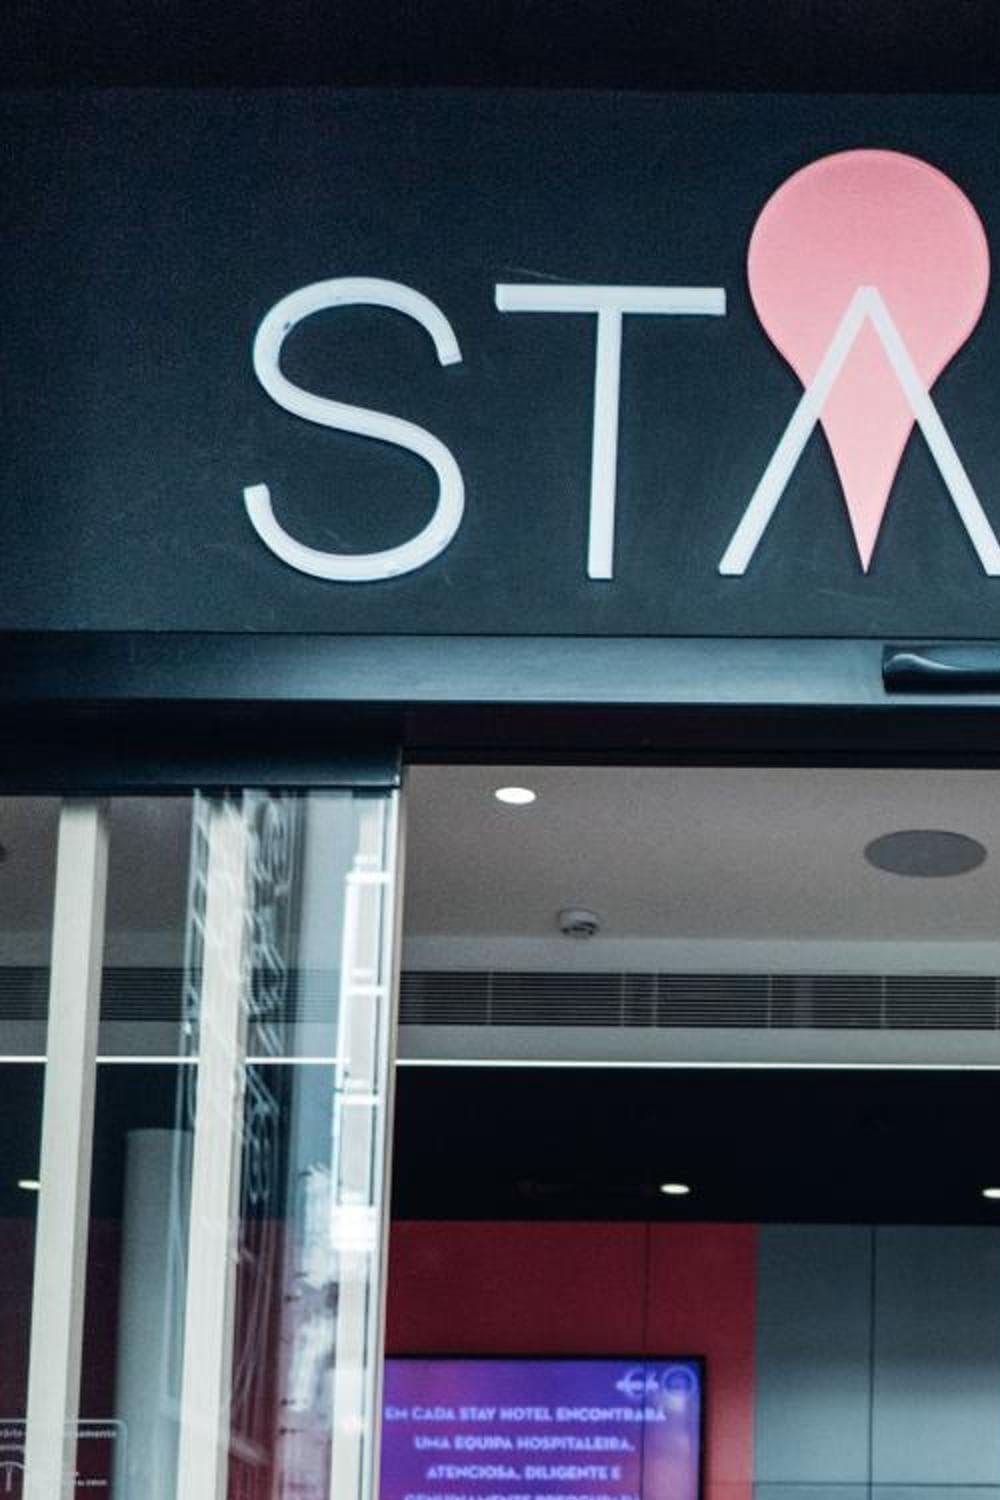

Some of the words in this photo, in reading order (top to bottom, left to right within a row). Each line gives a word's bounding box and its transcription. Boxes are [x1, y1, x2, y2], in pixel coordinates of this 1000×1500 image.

[411, 1407, 455, 1420] CADA
[459, 1407, 497, 1420] STAY
[499, 1407, 553, 1420] HOTEL
